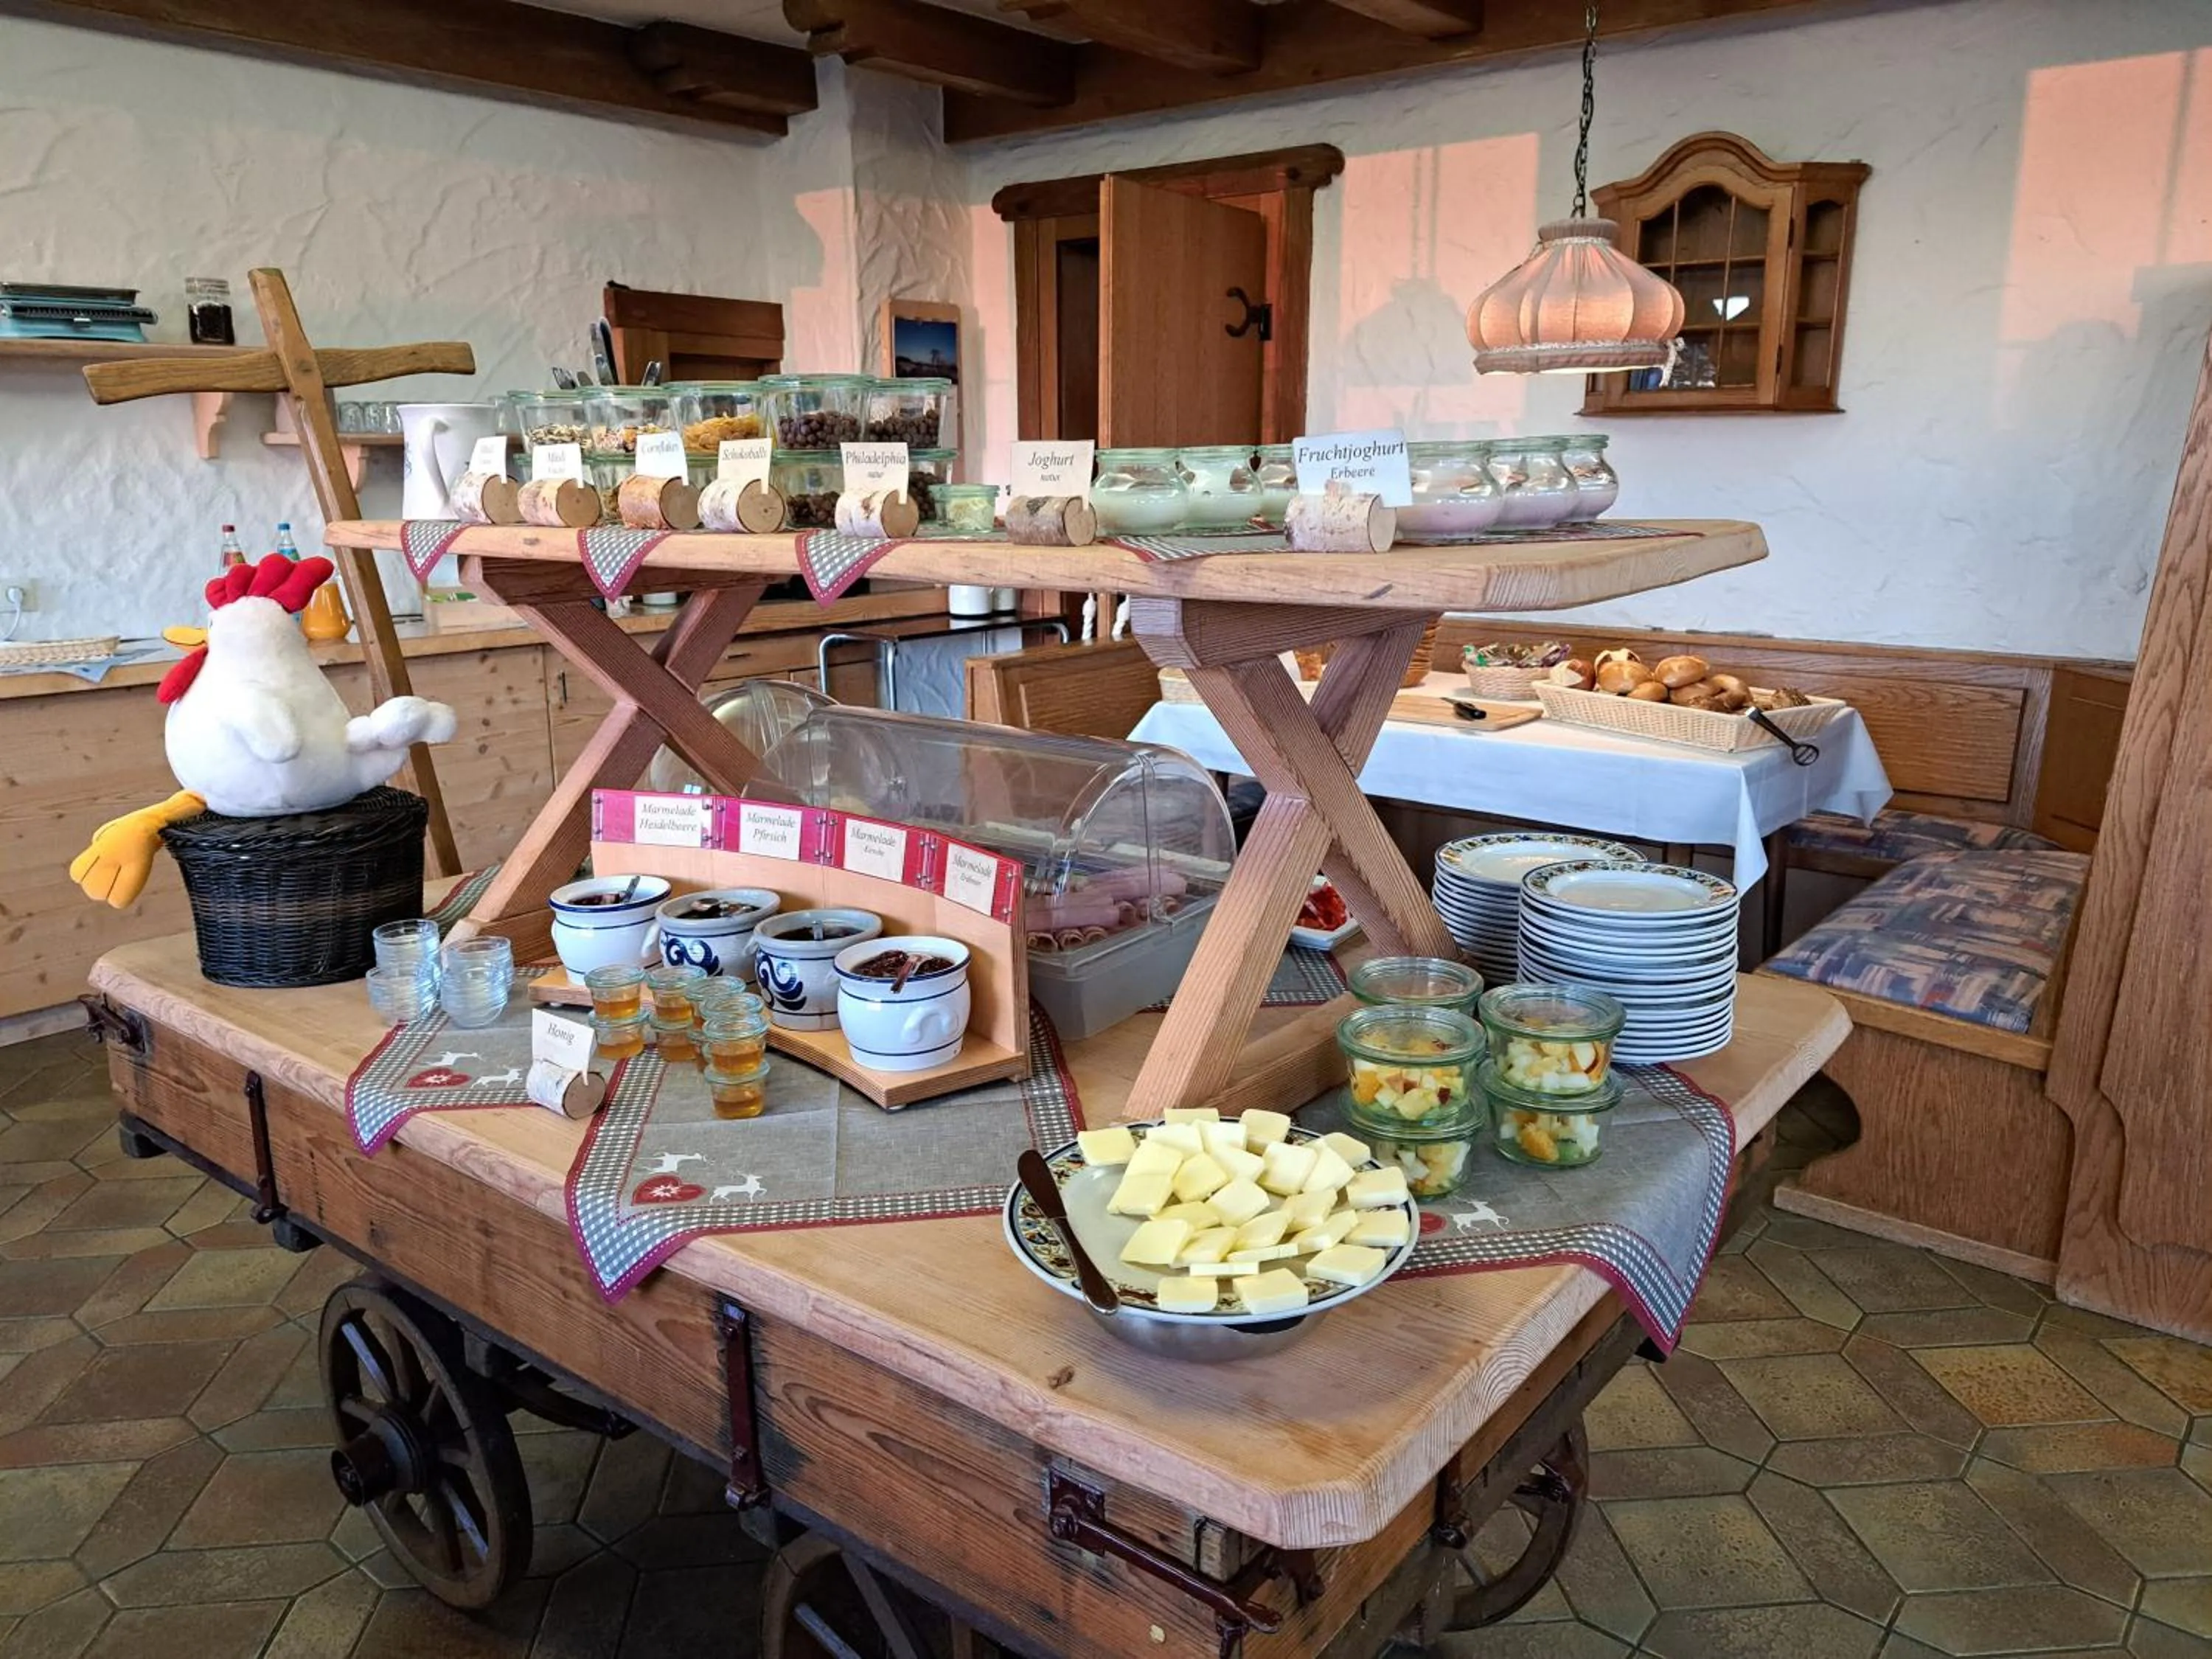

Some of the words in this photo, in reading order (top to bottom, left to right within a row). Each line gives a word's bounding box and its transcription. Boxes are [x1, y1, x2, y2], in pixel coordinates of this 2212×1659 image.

[846, 451, 906, 467] Philadelphia
[1028, 451, 1074, 470] Joghurt
[1298, 440, 1404, 463] Fruchtjoghurt
[641, 803, 697, 816] Marmelade
[639, 818, 698, 832] Heidelbeere
[746, 813, 796, 829] Marmelade
[752, 827, 787, 844] Pfirsich
[850, 827, 897, 847] Marmelade
[952, 853, 992, 878] Marmelade
[548, 1022, 575, 1046] Honig
